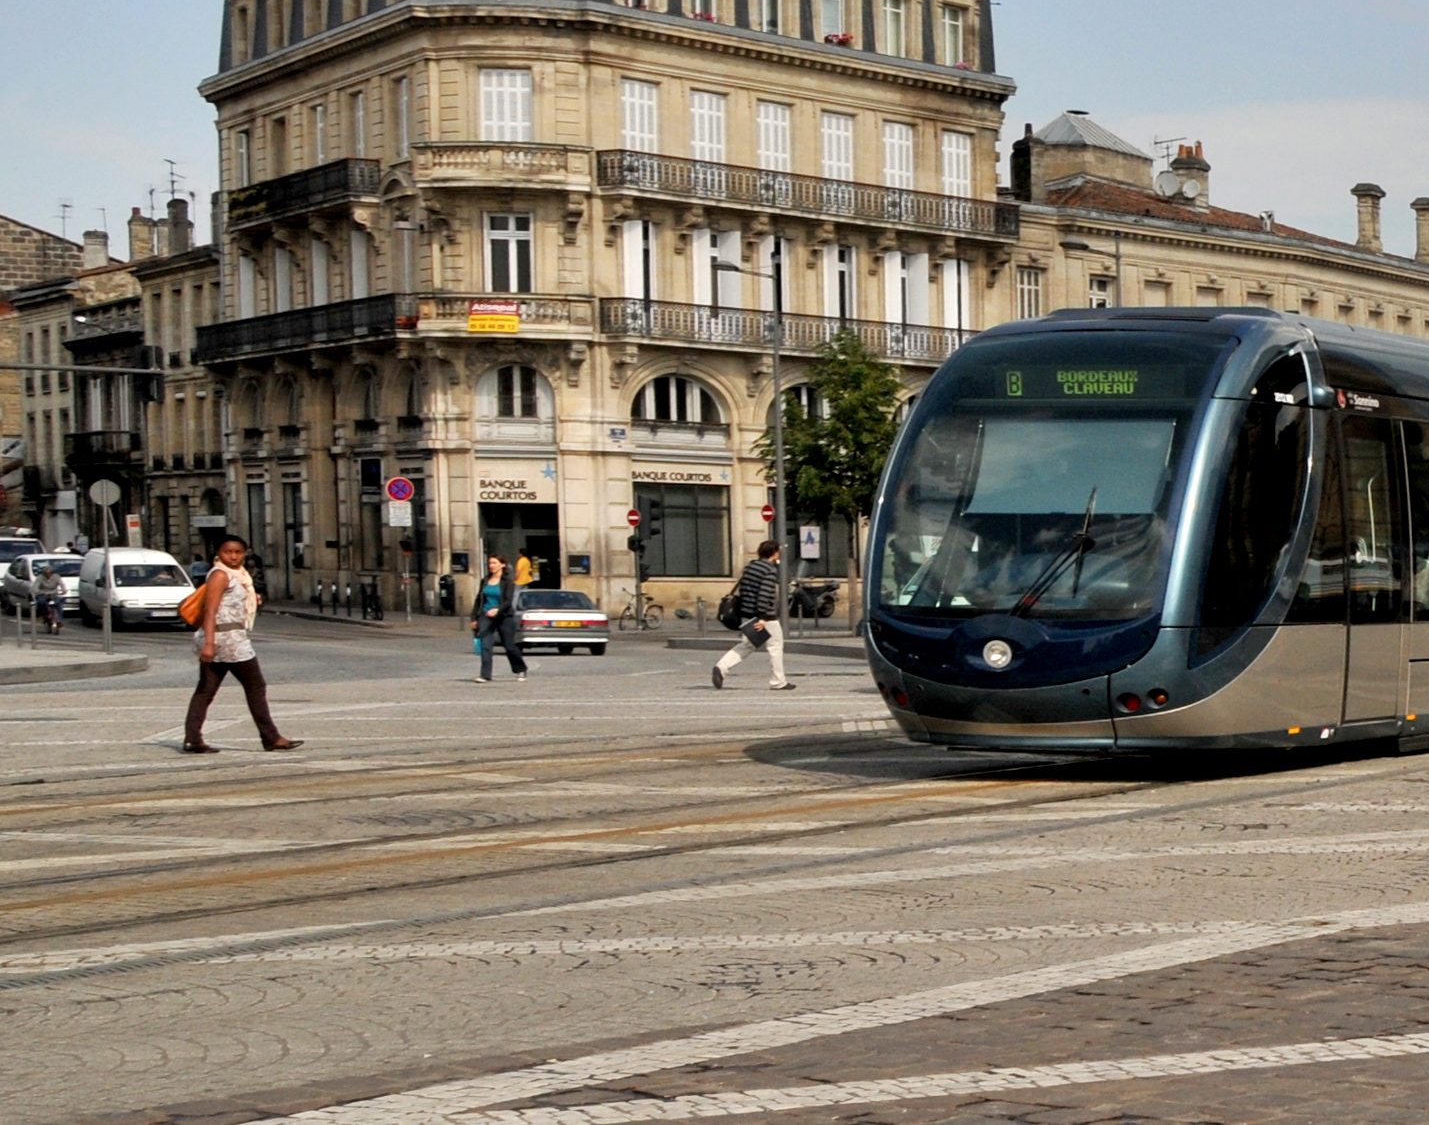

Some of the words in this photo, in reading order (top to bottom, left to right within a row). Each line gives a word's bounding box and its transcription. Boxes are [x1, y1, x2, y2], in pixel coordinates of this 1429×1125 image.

[1057, 371, 1138, 382] BORDEAUX
[1063, 383, 1134, 394] CLAVEAU
[631, 471, 667, 481] BANQUE
[669, 472, 712, 482] COURTOIS
[480, 479, 527, 490] BANQUE
[480, 491, 537, 500] COURTOIS
